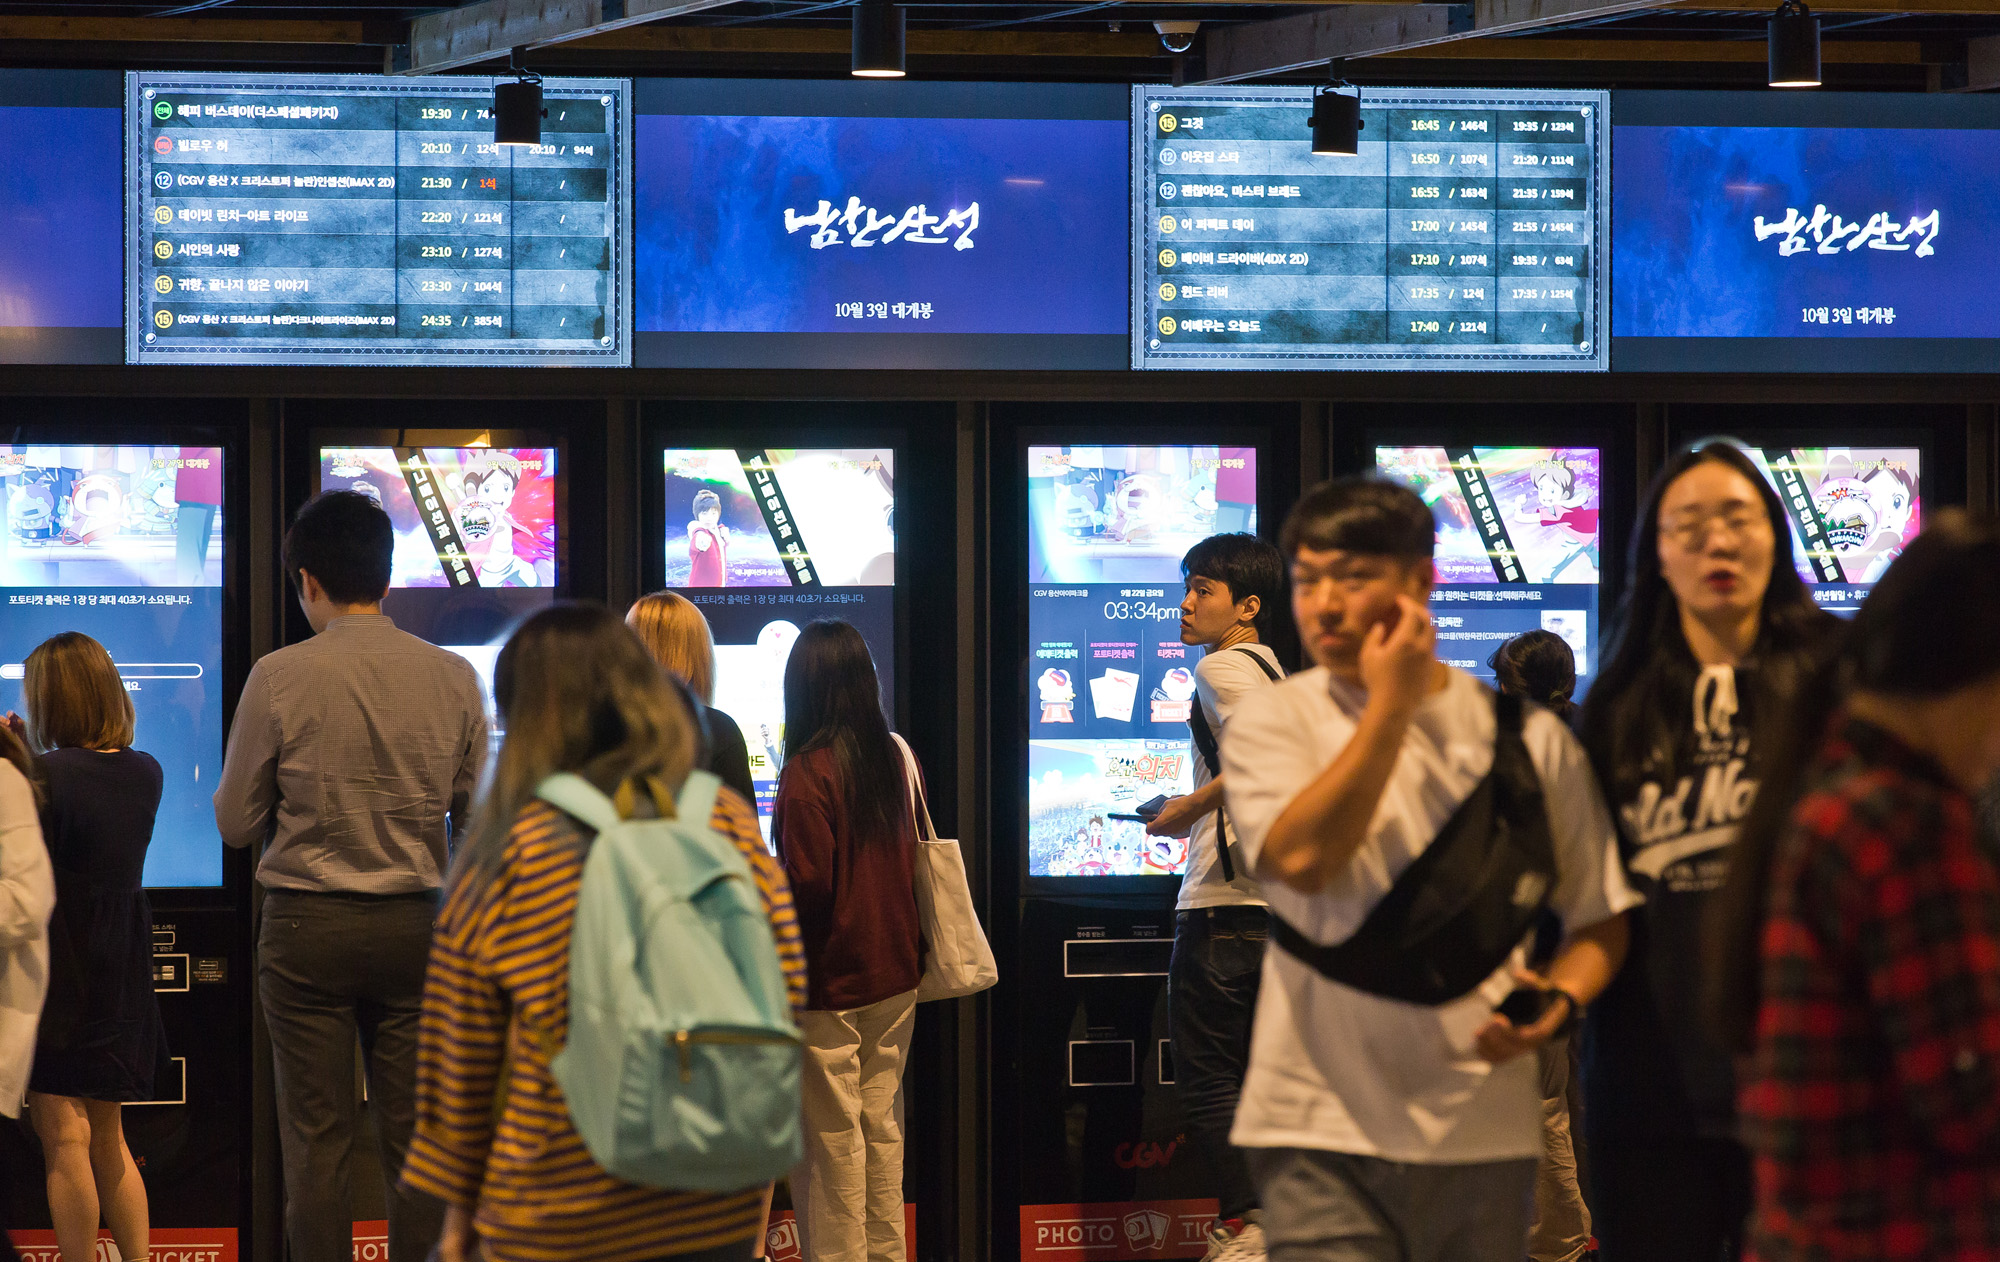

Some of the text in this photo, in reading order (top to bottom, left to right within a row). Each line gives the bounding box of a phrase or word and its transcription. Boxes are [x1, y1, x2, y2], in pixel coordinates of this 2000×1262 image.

[178, 105, 200, 117] 해피
[422, 109, 451, 119] 19:30
[477, 110, 495, 118] 74
[1181, 117, 1203, 129] 그것
[1411, 120, 1439, 130] 16:45
[1513, 122, 1538, 131] 19:35
[178, 140, 212, 152] 빌로우
[217, 140, 228, 152] 허
[422, 143, 451, 154] 20:10
[529, 145, 556, 154] 20:10
[574, 146, 593, 155] 94석
[1182, 152, 1214, 163] 이웃집
[1218, 152, 1239, 163] 스타
[1411, 154, 1439, 164] 16:50
[1461, 154, 1487, 165] 107석
[1513, 155, 1538, 164] 21:20
[208, 177, 228, 186] 용산
[241, 176, 290, 187] 크리스토퍼
[378, 177, 395, 188] 2D)
[422, 178, 451, 188] 21:30
[480, 179, 496, 189] 1석
[1182, 185, 1228, 198] 괜찮아요,
[1232, 186, 1264, 197] 미스터
[1411, 188, 1439, 197] 16:55
[1513, 189, 1538, 198] 21:35
[179, 210, 212, 221] 데이빗
[274, 210, 308, 221] 라이프
[422, 212, 451, 222] 22:20
[474, 213, 502, 224] 121석
[784, 196, 979, 251] 남한산성
[1232, 220, 1254, 231] 데이
[1411, 221, 1439, 231] 17:00
[1513, 222, 1537, 232] 21:55
[1754, 204, 1939, 258] 남한산성
[178, 244, 212, 256] 시인의
[216, 245, 240, 257] 사랑
[422, 247, 451, 257] 23:10
[474, 247, 502, 258] 127석
[1182, 253, 1213, 264] 베이비
[1290, 254, 1308, 266] 2D)
[1411, 255, 1439, 264] 17:10
[1513, 256, 1537, 265] 19:35
[178, 279, 205, 291] 귀향,
[209, 279, 243, 291] 끝나지
[247, 279, 270, 292] 않은
[274, 279, 308, 292] 이야기
[422, 282, 451, 292] 23:30
[474, 282, 502, 293] 104석
[1181, 286, 1203, 298] 윈드
[1207, 286, 1228, 298] 리버
[1411, 288, 1439, 298] 17:35
[1463, 288, 1484, 299] 12석
[1513, 289, 1537, 298] 17:35
[835, 302, 934, 319] 10월 3일 대개봉
[1802, 307, 1896, 324] 10월 3일 대개봉
[203, 315, 219, 324] 용산
[422, 316, 451, 326] 24:35
[474, 316, 502, 327] 385석
[1181, 320, 1224, 332] 여배우는
[1227, 321, 1261, 332] 오늘도
[1411, 322, 1439, 332] 17:40
[1460, 322, 1486, 333] 121석
[167, 459, 184, 468] 27일
[1869, 462, 1884, 470] 27일
[9, 595, 43, 605] 포토티켓
[45, 596, 71, 605] 출력은
[74, 596, 86, 605] 1장
[88, 596, 96, 605] 당
[99, 596, 115, 605] 최대
[118, 596, 146, 605] 40초가
[694, 594, 865, 604] 포토티켓 출력은 1장 당 최대 40초가 소요됩니다.
[1104, 602, 1180, 622] 03:34pm
[1115, 1142, 1176, 1169] CGV
[1038, 1226, 1114, 1244] PHOTO
